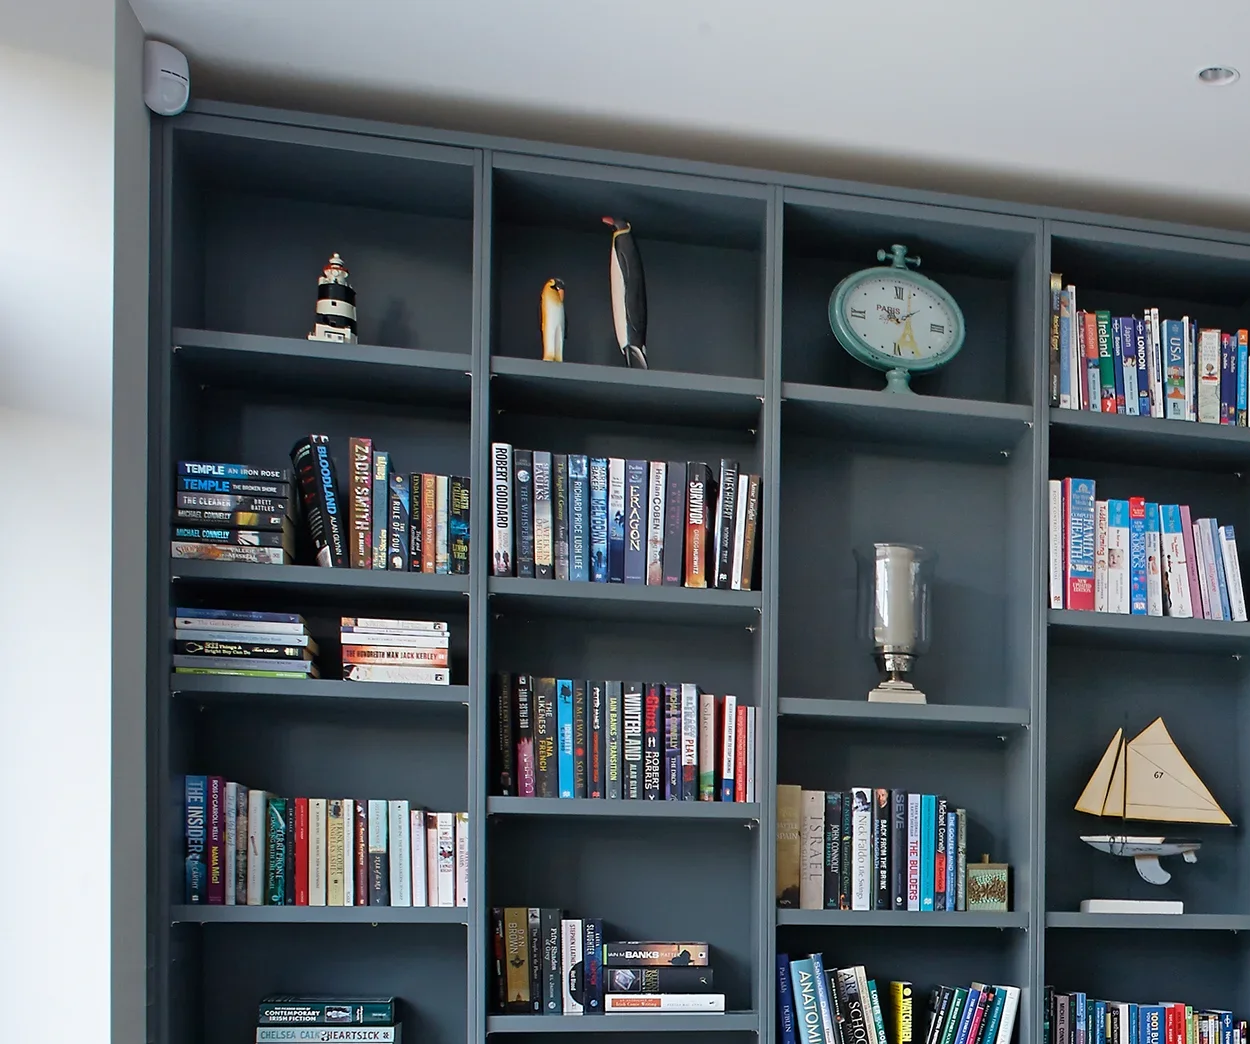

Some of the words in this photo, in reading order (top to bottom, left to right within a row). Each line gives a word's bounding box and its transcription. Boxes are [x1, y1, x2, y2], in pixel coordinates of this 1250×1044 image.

[877, 304, 900, 315] PARIS
[1088, 324, 1097, 350] London
[1098, 321, 1112, 359] Ireland
[1124, 326, 1133, 349] Japan
[1170, 337, 1182, 362] USA
[1137, 336, 1147, 371] LONDON
[185, 464, 225, 475] TEMPLE
[355, 445, 371, 484] ZADIE
[496, 448, 508, 483] ROBERT
[183, 479, 229, 492] TEMPLE
[317, 446, 337, 515] BLOODLAND
[535, 463, 543, 501] FAULKS
[183, 496, 197, 505] THE
[355, 486, 371, 531] SMITH
[497, 485, 509, 529] GODDARD
[575, 481, 583, 511] RICHARD
[690, 482, 703, 525] SURVIVOR
[392, 501, 400, 520] RULE
[575, 513, 583, 533] PRICE
[202, 530, 229, 539] CONNELLY
[330, 516, 340, 534] ALAN
[392, 522, 400, 531] OF
[333, 534, 343, 556] GLYNN
[391, 534, 400, 553] FOUR
[575, 536, 583, 553] LUSH
[1071, 517, 1083, 560] HEALTH
[1083, 518, 1095, 560] FAMILY
[575, 555, 583, 570] LIFE
[538, 696, 546, 735] LIKENESS
[625, 693, 641, 761] WINTERLAND
[646, 696, 659, 734] Ghost
[539, 740, 547, 772] FRENCH
[645, 751, 653, 790] HARRIS
[652, 752, 660, 790] ROBERT
[1154, 771, 1163, 779] 67
[189, 780, 204, 803] THE
[895, 794, 904, 829] SEVE
[939, 800, 947, 826] Michael
[187, 806, 204, 853] INSIDER
[831, 825, 839, 842] JOHN
[857, 815, 867, 836] Nick
[880, 819, 888, 836] BACK
[809, 816, 823, 882] ISRAEL
[857, 838, 867, 863] Faldo
[880, 837, 888, 856] FROM
[909, 840, 918, 857] THE
[937, 828, 946, 853] Connelly
[830, 842, 839, 874] CONNOLLY
[909, 860, 918, 901] BUILDERS
[509, 922, 519, 955] BROWN
[517, 929, 525, 947] DAN
[549, 928, 558, 944] Fifty
[586, 924, 595, 956] SLAUGHTER
[783, 1005, 793, 1033] DUBLIN
[902, 998, 912, 1042] WATCHMEN
[1151, 1012, 1159, 1031] 1001
[327, 1032, 380, 1040] HEARTSICK
